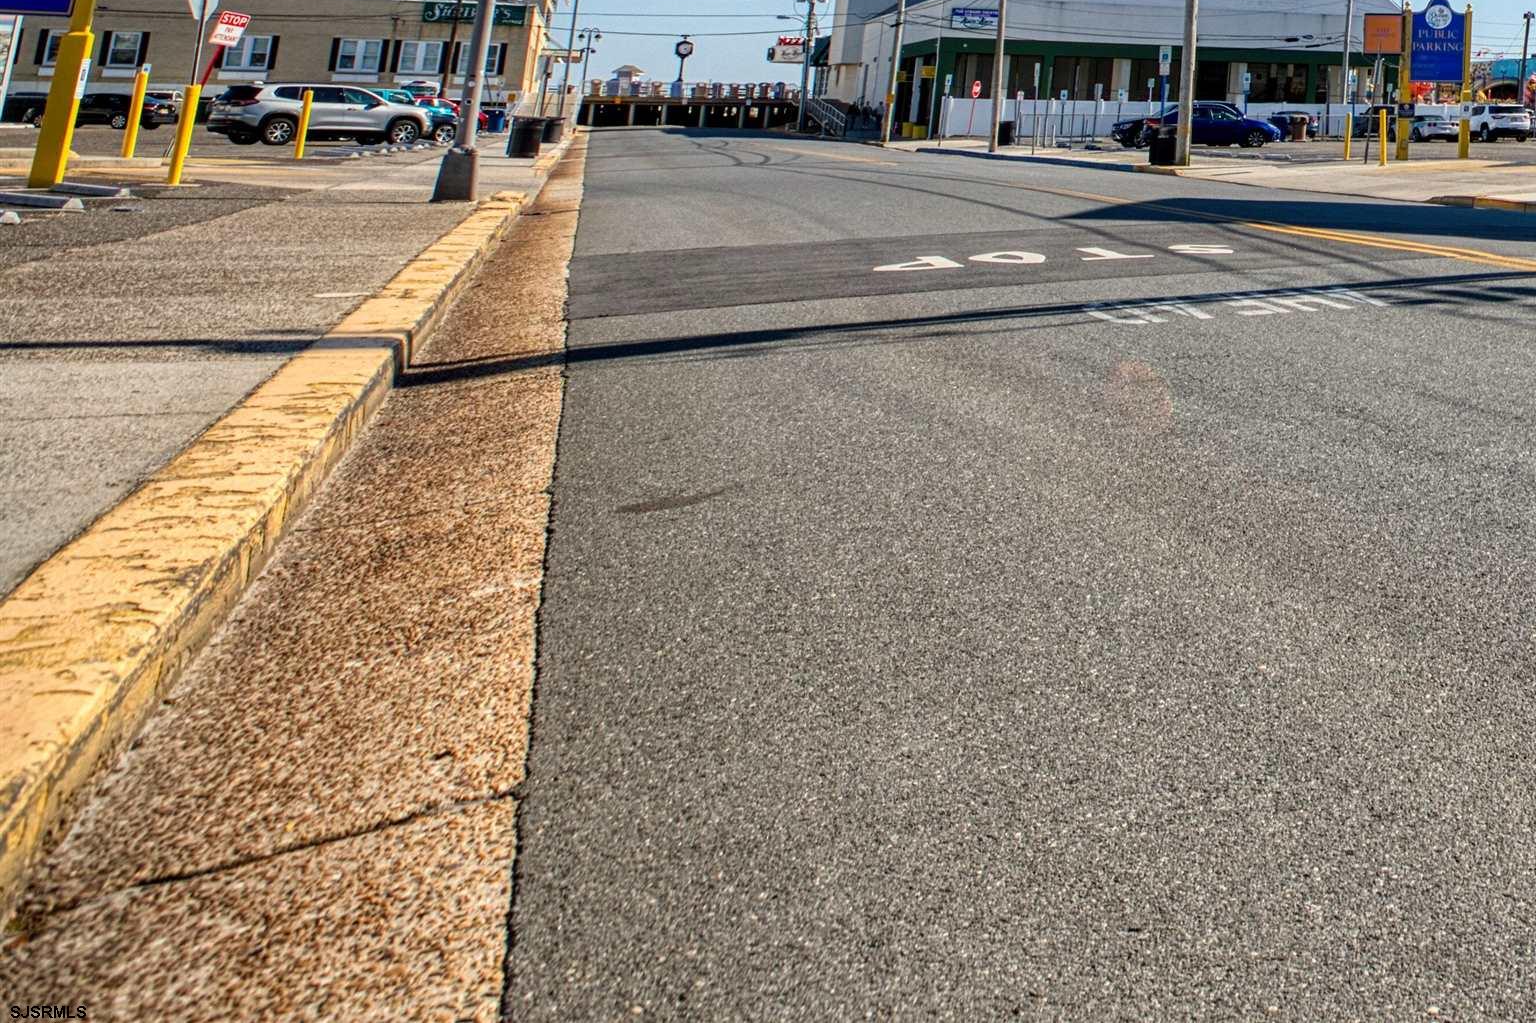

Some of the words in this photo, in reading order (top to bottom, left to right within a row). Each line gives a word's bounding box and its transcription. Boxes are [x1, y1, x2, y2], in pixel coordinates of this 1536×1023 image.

[221, 14, 248, 26] STOP
[1418, 29, 1457, 39] PUBLIC
[1412, 41, 1464, 53] PARKING
[873, 243, 1235, 272] STOP
